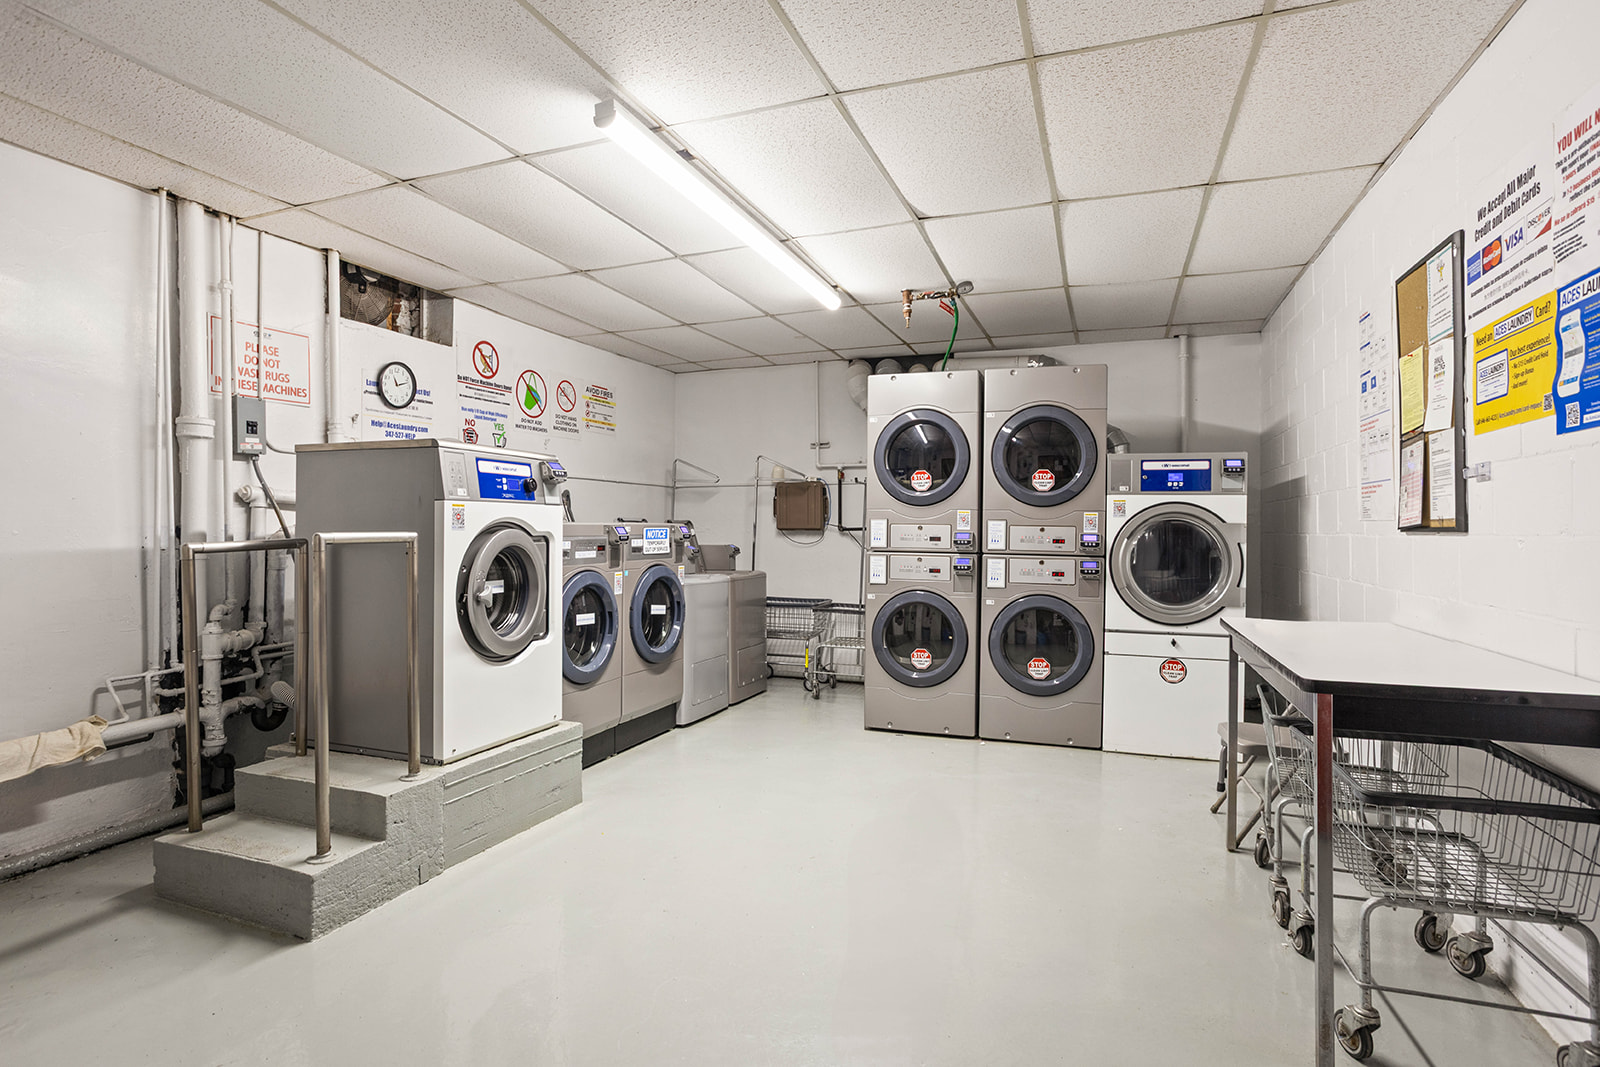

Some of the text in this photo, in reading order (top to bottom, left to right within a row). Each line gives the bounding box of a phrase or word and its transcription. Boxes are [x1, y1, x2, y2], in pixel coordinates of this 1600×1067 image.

[1557, 130, 1572, 154] YOU
[1574, 114, 1592, 142] WILL
[1478, 164, 1536, 222] We Accept All Major
[1475, 182, 1540, 242] Credit and Debit Cards
[1504, 227, 1523, 251] VISA
[1562, 286, 1580, 307] ACES
[1476, 300, 1551, 347] Need an ACES LAUNDRY Card?
[244, 354, 259, 366] DO
[1510, 349, 1518, 358] Our
[265, 371, 290, 383] RUGS
[586, 386, 613, 399] AVOID FIRES
[465, 418, 476, 427] NO
[494, 422, 505, 431] YES
[646, 530, 668, 539] NOTICE
